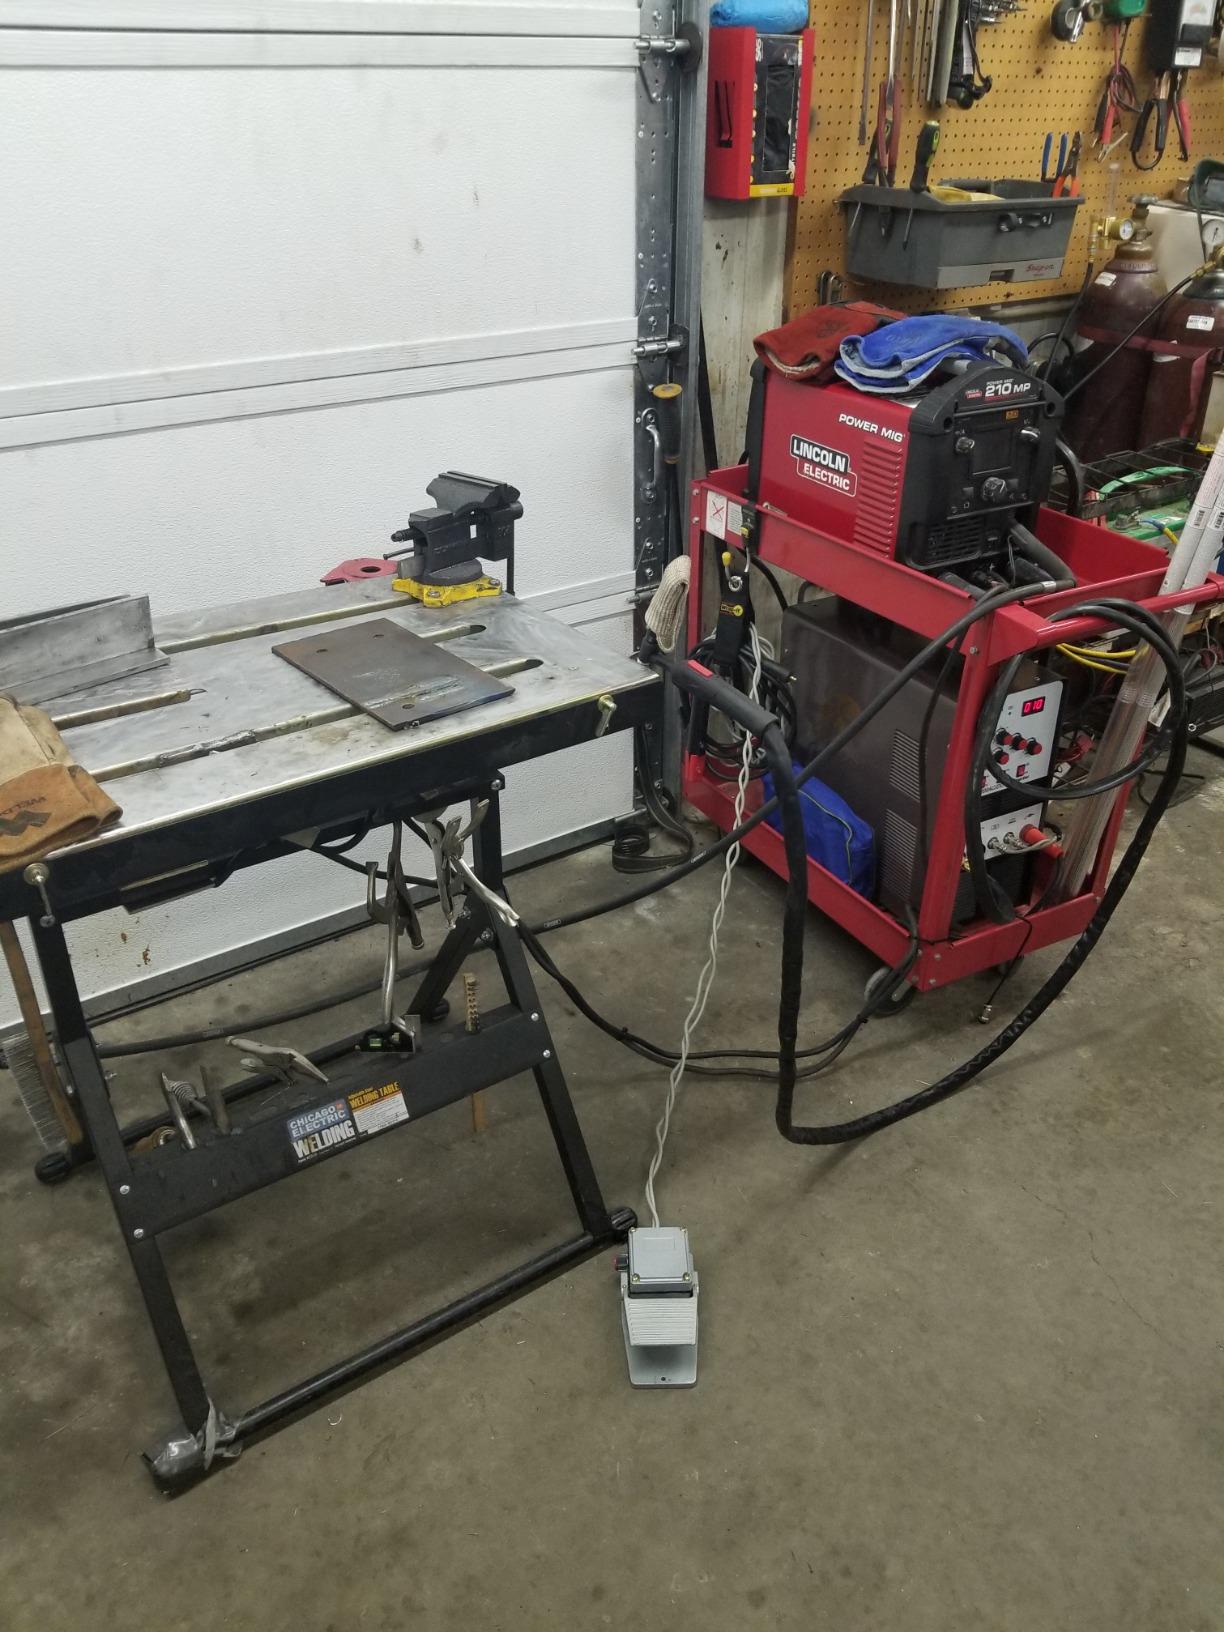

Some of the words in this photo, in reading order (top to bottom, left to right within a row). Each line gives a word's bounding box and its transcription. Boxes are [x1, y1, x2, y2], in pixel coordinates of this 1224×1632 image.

[984, 383, 1012, 397] 210
[1013, 382, 1031, 394] MP
[838, 413, 879, 433] POWER
[880, 427, 903, 442] MIG
[793, 438, 846, 472] LINCOLN
[803, 462, 850, 491] ELECTRIC
[349, 1090, 380, 1108] WELDING
[379, 1082, 399, 1097] TABLE
[290, 1105, 336, 1129] CHICAGO
[292, 1110, 346, 1138] ELECTRIC
[292, 1120, 356, 1158] WELDING
